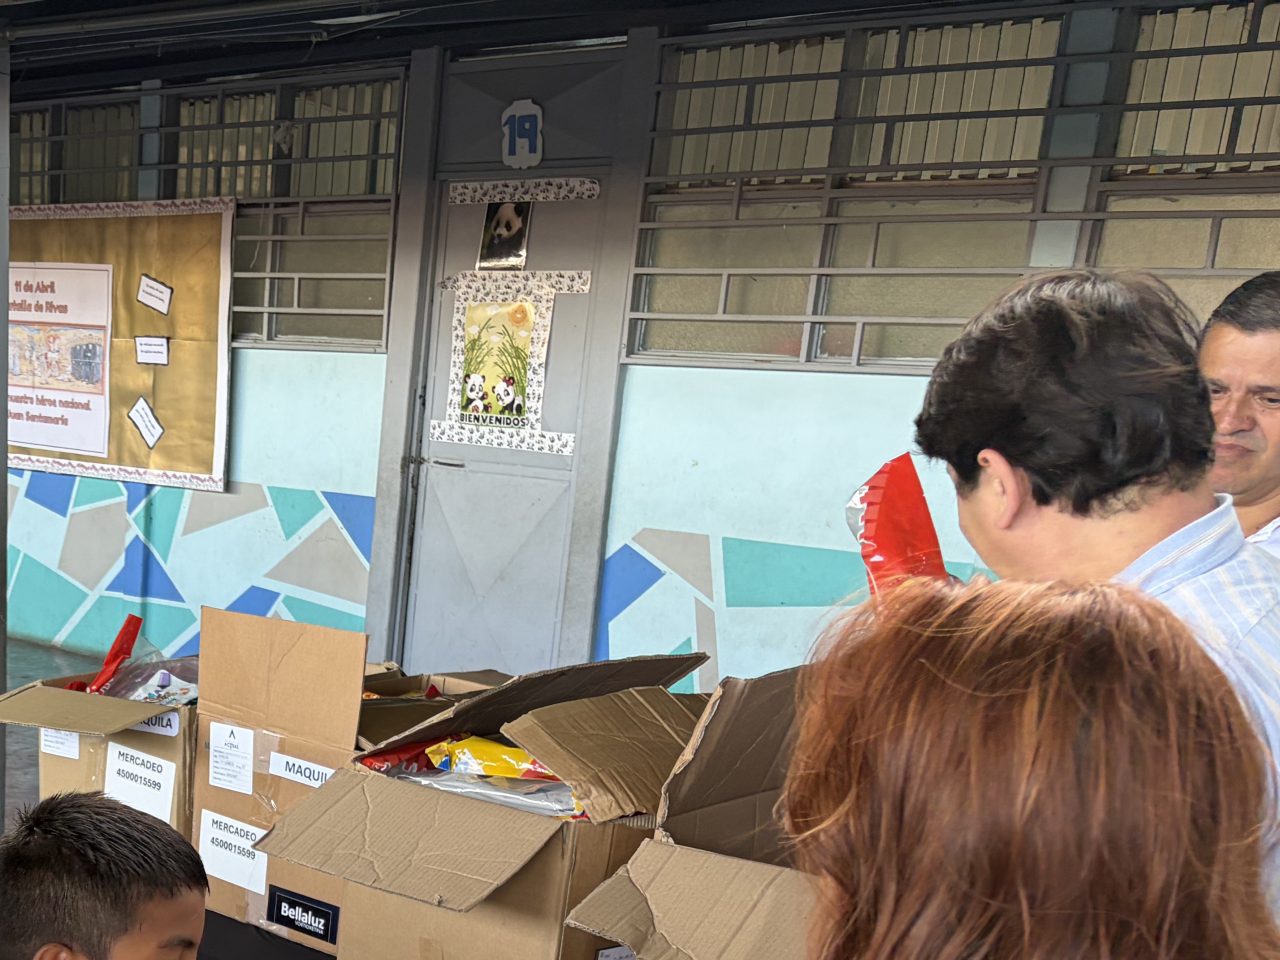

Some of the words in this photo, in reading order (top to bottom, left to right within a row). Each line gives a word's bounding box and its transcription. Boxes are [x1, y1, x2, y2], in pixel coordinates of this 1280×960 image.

[503, 114, 538, 156] 19
[23, 281, 34, 293] de
[35, 281, 56, 294] Abril
[34, 300, 44, 313] de
[45, 300, 69, 314] Rivas
[460, 412, 526, 427] BIENVENIDOS
[117, 750, 163, 774] MERCADEO
[116, 768, 162, 791] 4500015599
[211, 818, 257, 842] MERCADEO
[210, 836, 256, 860] 4500015599
[281, 902, 325, 930] Bellaluz
